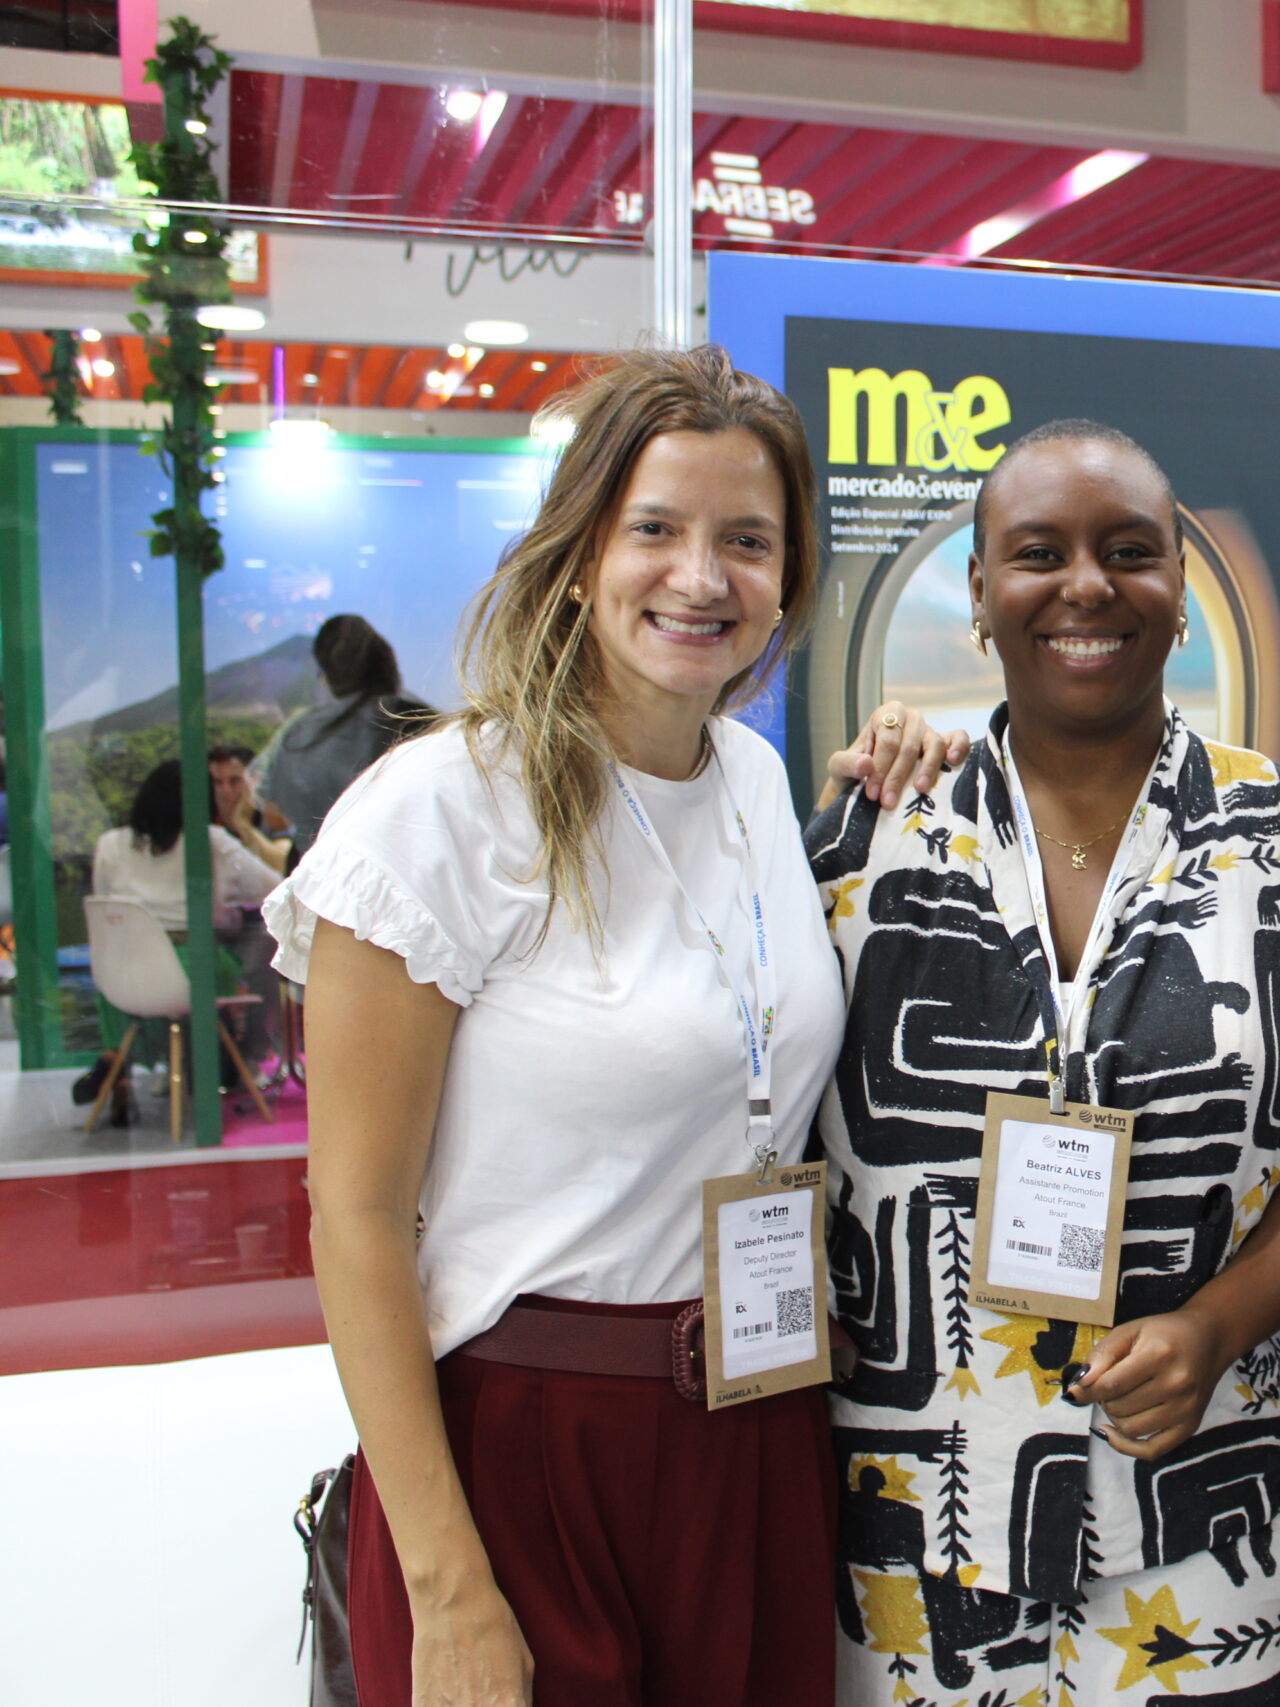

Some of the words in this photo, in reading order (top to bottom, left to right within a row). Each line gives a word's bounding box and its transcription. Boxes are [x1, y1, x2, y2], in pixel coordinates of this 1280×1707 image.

[828, 367, 1011, 473] m&e
[863, 507, 899, 521] Especial
[831, 542, 874, 553] Setembro
[876, 543, 899, 554] 2024
[1093, 1112, 1126, 1127] wtm
[1058, 1138, 1090, 1154] wtm
[794, 1169, 820, 1182] wtm
[1026, 1160, 1062, 1174] Beatriz
[1065, 1167, 1102, 1180] ALVES
[1019, 1176, 1061, 1190] Assistante
[1063, 1183, 1104, 1198] Promotion
[1034, 1193, 1056, 1204] Atout
[1058, 1197, 1086, 1209] France
[762, 1205, 788, 1219] wtm
[735, 1238, 765, 1249] Izabele
[767, 1230, 804, 1244] Pesinato
[744, 1254, 768, 1265] Deputy
[770, 1249, 797, 1260] Director
[769, 1265, 793, 1275] France
[976, 1296, 1017, 1308] ILHABELA
[716, 1388, 752, 1403] ILHABELA
